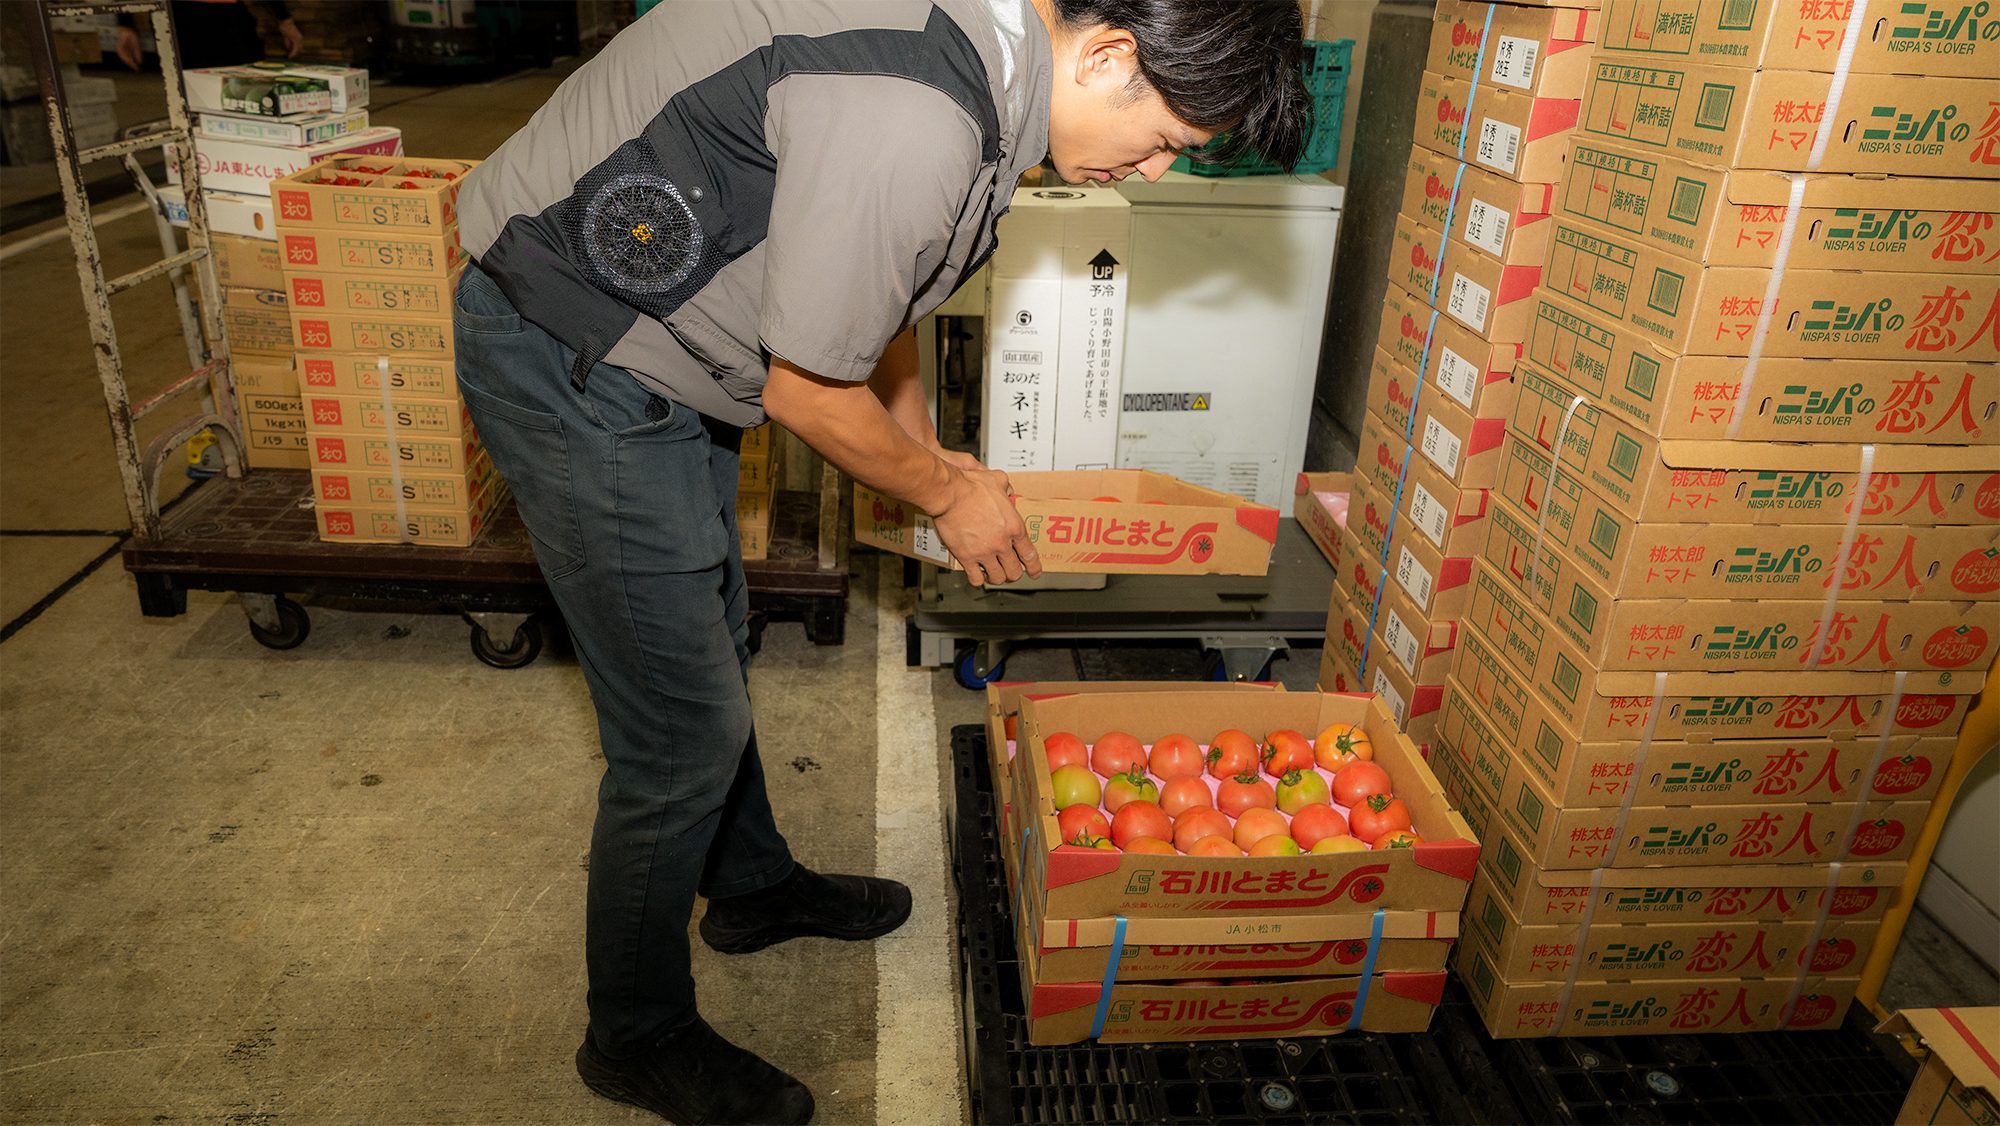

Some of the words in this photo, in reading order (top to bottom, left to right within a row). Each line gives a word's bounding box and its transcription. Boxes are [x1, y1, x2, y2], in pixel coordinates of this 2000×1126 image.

[1656, 12, 1694, 35] 満杯詰
[1500, 41, 1514, 59] R秀
[1887, 40, 1931, 53] NISPA'S
[1936, 42, 1976, 55] LOVER
[1636, 103, 1672, 128] 満杯詰
[1484, 123, 1497, 142] R秀
[1858, 141, 1901, 154] NISPA'S
[1906, 143, 1944, 156] LOVER
[215, 160, 285, 179] JA東とくしま
[1612, 188, 1646, 216] 満杯詰
[373, 206, 388, 225] S
[1827, 208, 2000, 263] ニシパの恋
[1823, 240, 1865, 252] NISPA'S
[1870, 241, 1906, 253] LOVER
[378, 247, 394, 265] S
[1094, 266, 1112, 279] UP
[1089, 284, 1115, 298] 予冷
[1593, 273, 1627, 302] 満杯詰
[383, 291, 397, 308] S
[1716, 322, 1769, 341] トマ
[1800, 332, 1840, 343] NISPA'S
[1844, 333, 1880, 344] LOVER
[391, 332, 405, 349] S
[1004, 353, 1040, 363] 山口県産
[1554, 337, 1568, 372] L
[1574, 350, 1606, 382] 満杯詰
[391, 373, 405, 387] S
[1003, 371, 1040, 385] おのだ
[1123, 393, 1190, 412] CYCLOPENTANE
[1777, 370, 1981, 436] ニシパの恋人
[397, 412, 412, 426] S
[1773, 415, 1812, 425] NISPA'S
[1816, 416, 1851, 427] LOVER
[263, 436, 282, 446] バラ
[1537, 415, 1551, 450] L
[400, 447, 414, 461] S
[1671, 471, 1728, 487] 桃太郎
[402, 485, 416, 499] S
[1525, 476, 1538, 512] L
[1668, 493, 1718, 509] トマト
[1747, 500, 1784, 509] NISPA'S
[1788, 500, 1821, 509] LOVER
[408, 523, 421, 536] S
[1046, 515, 1174, 547] 石川とまと
[1649, 546, 1705, 563] 桃太郎
[1729, 533, 1922, 592] ニシパの恋人
[1511, 545, 1523, 582] L
[1646, 568, 1696, 584] トマト
[1725, 575, 1762, 583] NISPA'S
[1767, 575, 1799, 583] LOVER
[1630, 624, 1683, 640] 桃太郎
[1706, 611, 1899, 667] ニシパの恋人
[1508, 629, 1536, 668] 満杯詰
[1627, 645, 1676, 660] トマト
[1704, 651, 1740, 660] NISPA'S
[1744, 651, 1776, 660] LOVER
[1494, 694, 1519, 732] 満杯詰
[1721, 716, 1752, 726] LOVER
[1896, 704, 1949, 721] びらとり町
[1665, 748, 1847, 796] ニシパの恋人
[1873, 770, 1926, 788] びらとり町
[1701, 784, 1731, 792] LOVER
[1643, 811, 1819, 859] ニシパの恋人
[1568, 844, 1610, 860] トマト
[1678, 847, 1708, 856] LOVER
[1159, 868, 1329, 894] 石川とまと
[1545, 901, 1587, 914] トマト
[1653, 904, 1683, 913] LOVER
[1225, 923, 1282, 936] JA小松市
[1601, 930, 1775, 972] ニシパの恋人
[1530, 957, 1571, 972] トマト
[1139, 997, 1300, 1022] 石川とまと
[1587, 987, 1758, 1030] ニシパの恋人
